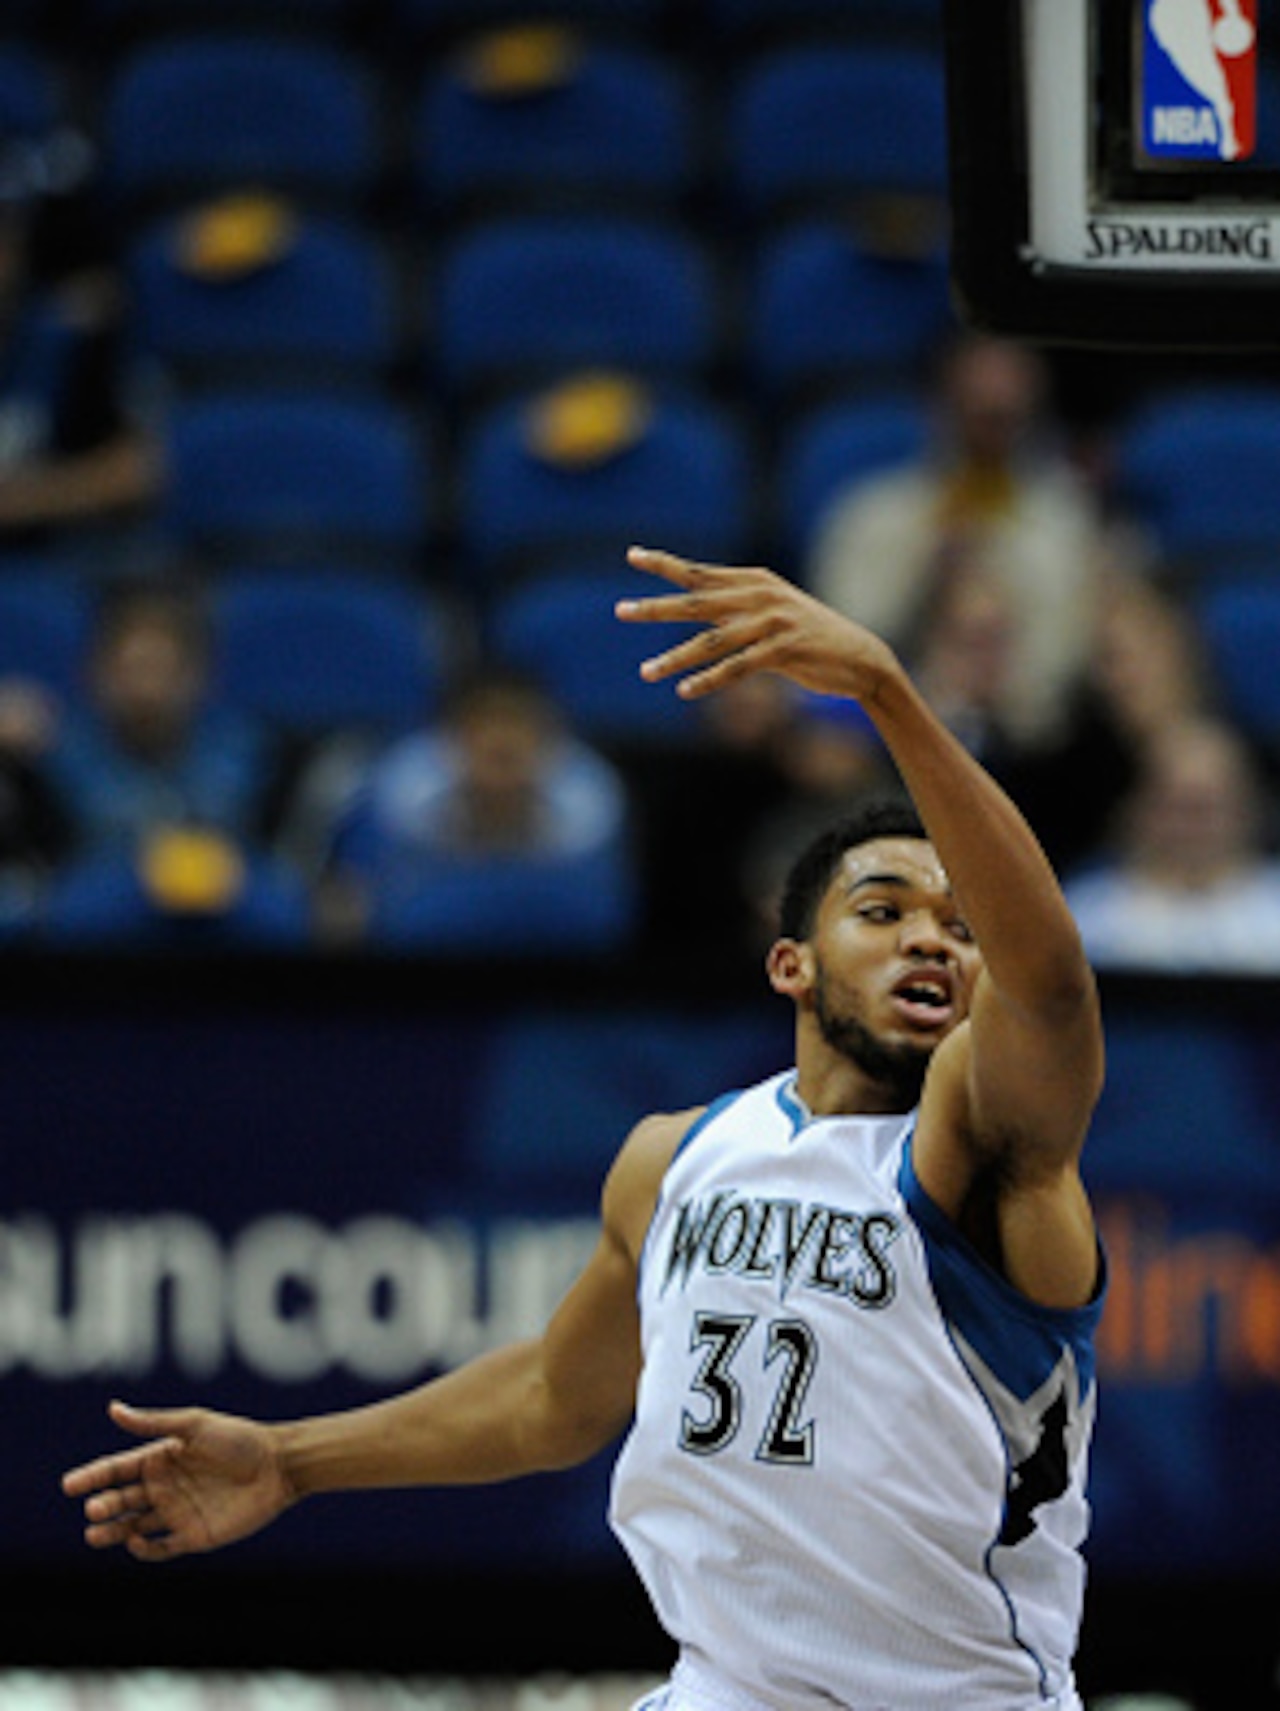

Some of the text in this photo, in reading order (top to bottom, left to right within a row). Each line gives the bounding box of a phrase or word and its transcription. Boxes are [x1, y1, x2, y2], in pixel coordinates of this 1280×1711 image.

[1152, 106, 1218, 145] NBA
[1085, 217, 1274, 262] SPALDING
[658, 1190, 899, 1310] WOLVES
[676, 1310, 820, 1466] 32
